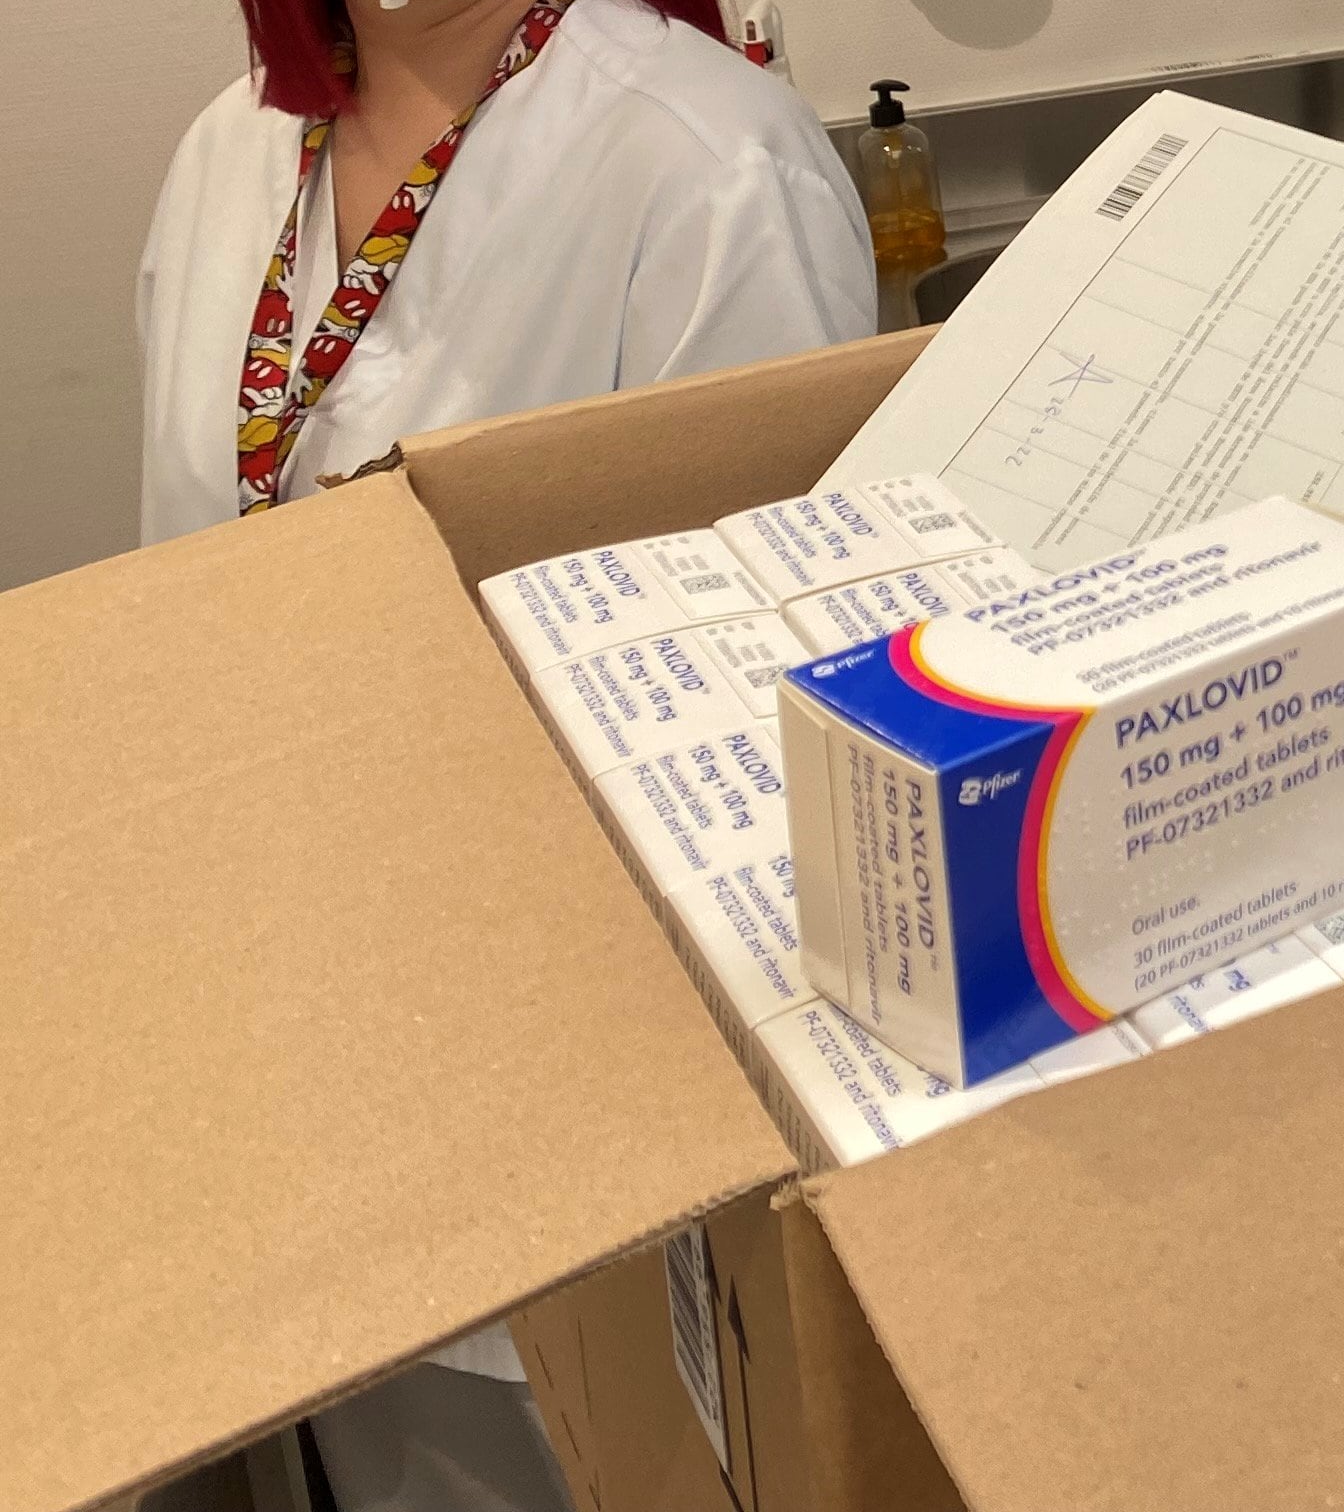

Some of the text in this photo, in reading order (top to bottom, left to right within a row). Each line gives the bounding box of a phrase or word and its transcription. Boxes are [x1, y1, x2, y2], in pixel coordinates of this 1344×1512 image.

[822, 493, 873, 535] PAXLOVID
[591, 551, 640, 596] PAXLOVID
[897, 573, 952, 618] PAXLOVI
[964, 556, 1136, 623] PAXLOVID
[619, 647, 678, 722] 150 mg 100 mg
[650, 638, 704, 691] PAXLOVID
[722, 733, 782, 794] PAXLOVID
[1120, 750, 1170, 789] 150
[1180, 733, 1220, 768] mg
[1229, 723, 1246, 742] +
[1256, 693, 1301, 733] 100
[688, 745, 753, 830] 150 mg 100 mg
[981, 769, 1021, 800] Pfizer
[1124, 726, 1329, 829] film-coated tablets
[1126, 779, 1274, 861] PF-07321332
[1281, 755, 1319, 792] and
[861, 892, 876, 934] and
[883, 769, 911, 996] 150 mg + 100 mg
[1132, 909, 1164, 935] Oral
[1134, 880, 1297, 968] 30 film-coated tablets
[1247, 905, 1290, 935] tablets
[1293, 893, 1317, 914] and
